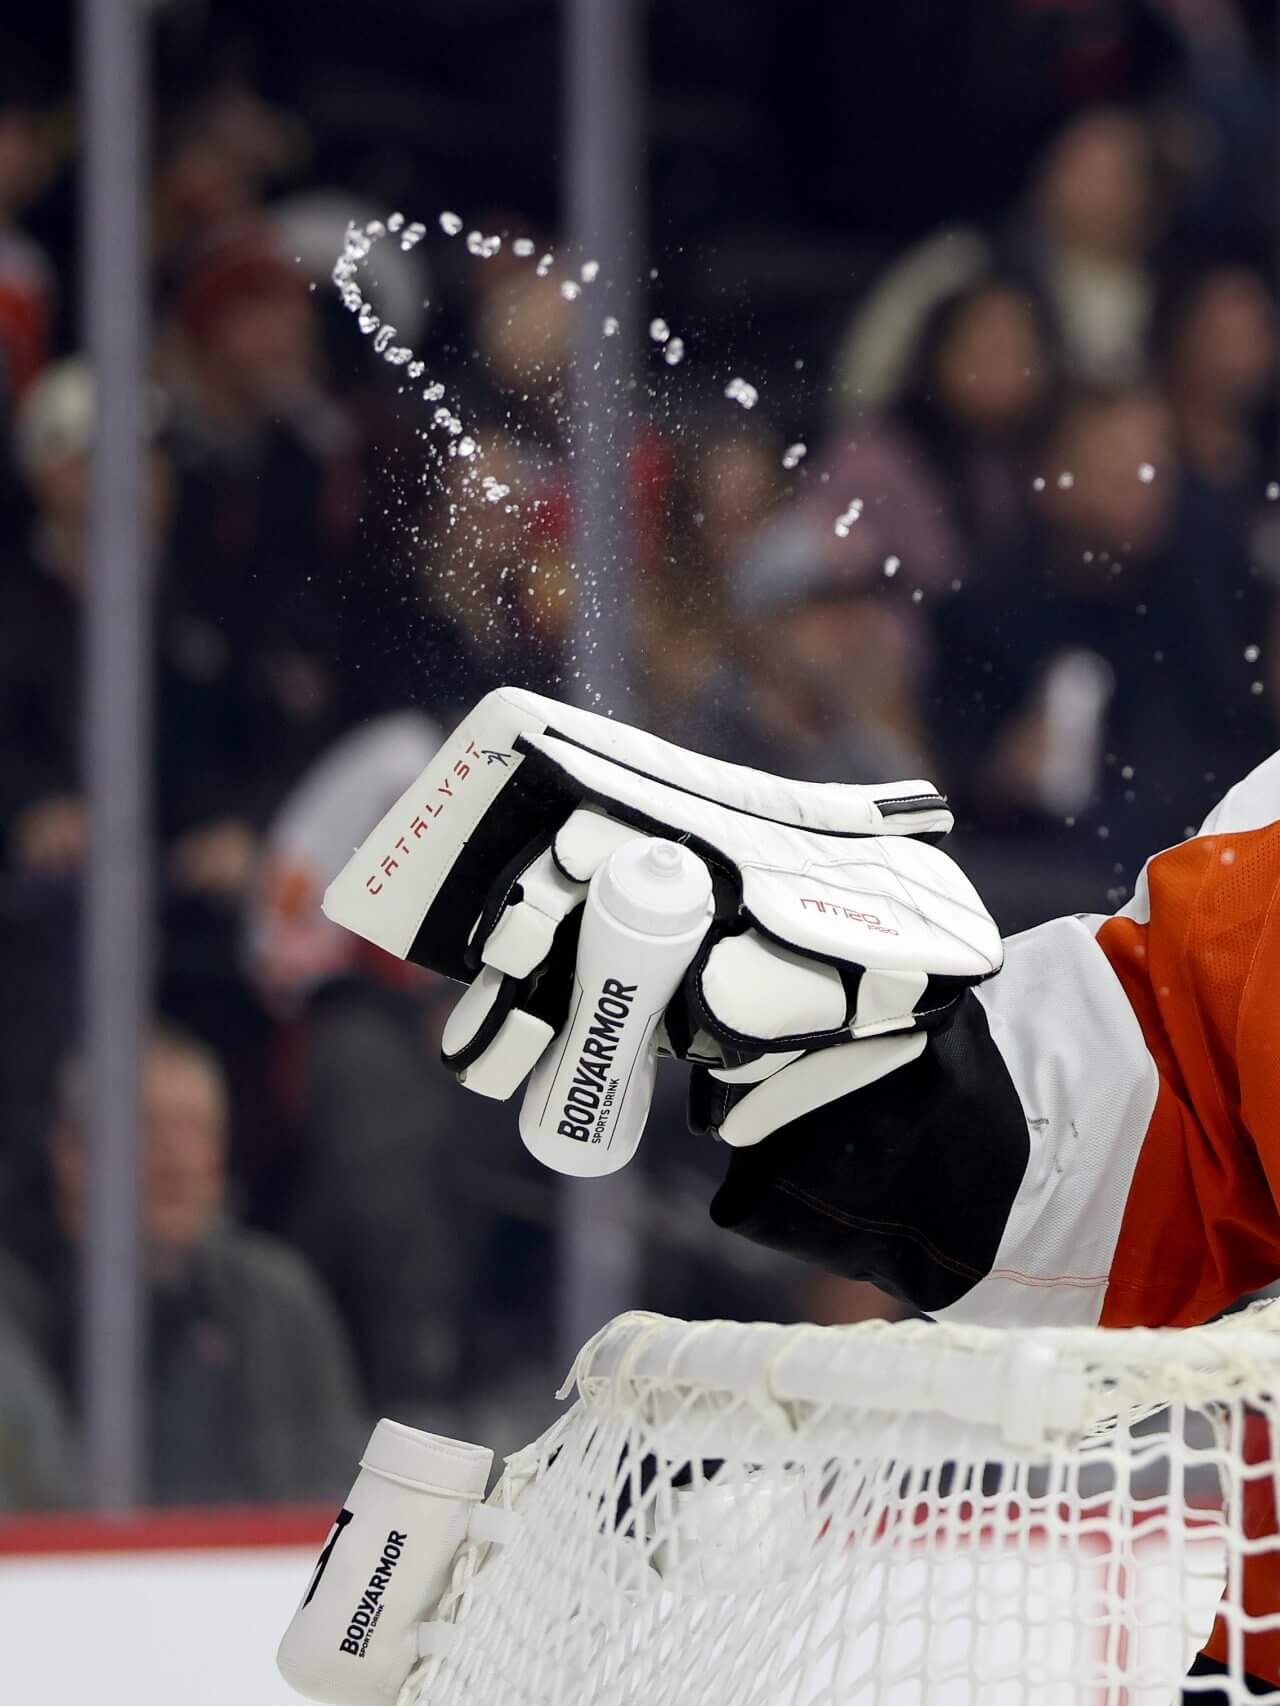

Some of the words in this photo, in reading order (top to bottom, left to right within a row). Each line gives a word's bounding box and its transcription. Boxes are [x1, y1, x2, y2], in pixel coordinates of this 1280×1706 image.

[366, 741, 480, 895] CATALYST
[557, 978, 639, 1143] BODYARMOR
[591, 1109, 610, 1144] SPORTS
[603, 1078, 620, 1107] DRINK
[339, 1530, 407, 1657] BODYARMOR
[358, 1627, 374, 1658] SPORTS
[370, 1604, 385, 1627] DRINK
